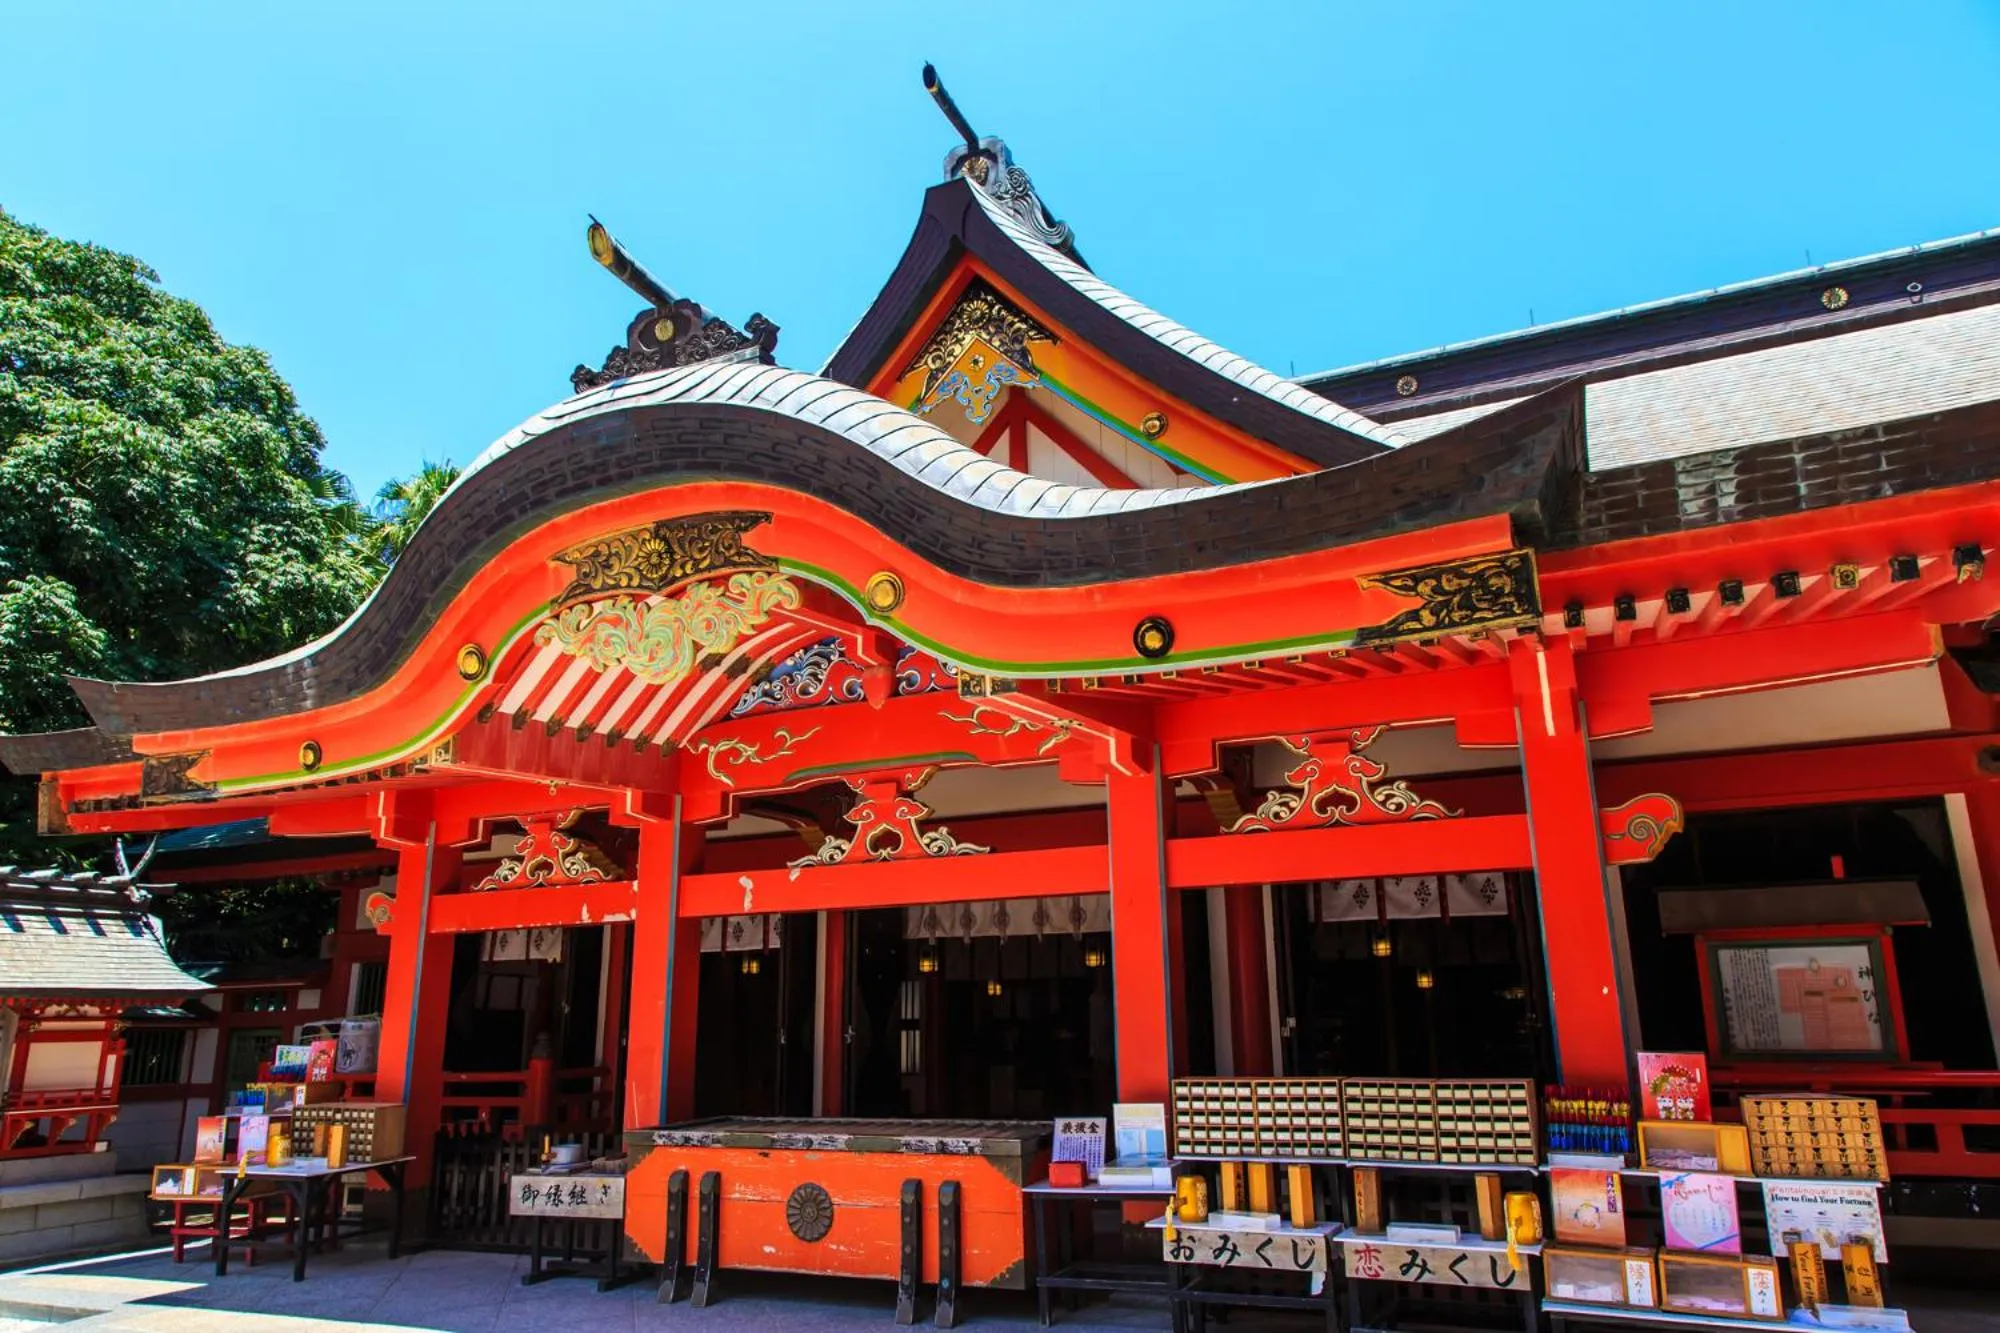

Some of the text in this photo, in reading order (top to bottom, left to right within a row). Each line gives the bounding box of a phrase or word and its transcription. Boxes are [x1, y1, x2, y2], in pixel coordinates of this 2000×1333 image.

[1771, 1194, 1789, 1202] How
[1791, 1194, 1799, 1202] to
[1820, 1195, 1837, 1204] Your
[1169, 1232, 1316, 1269] おみくじ
